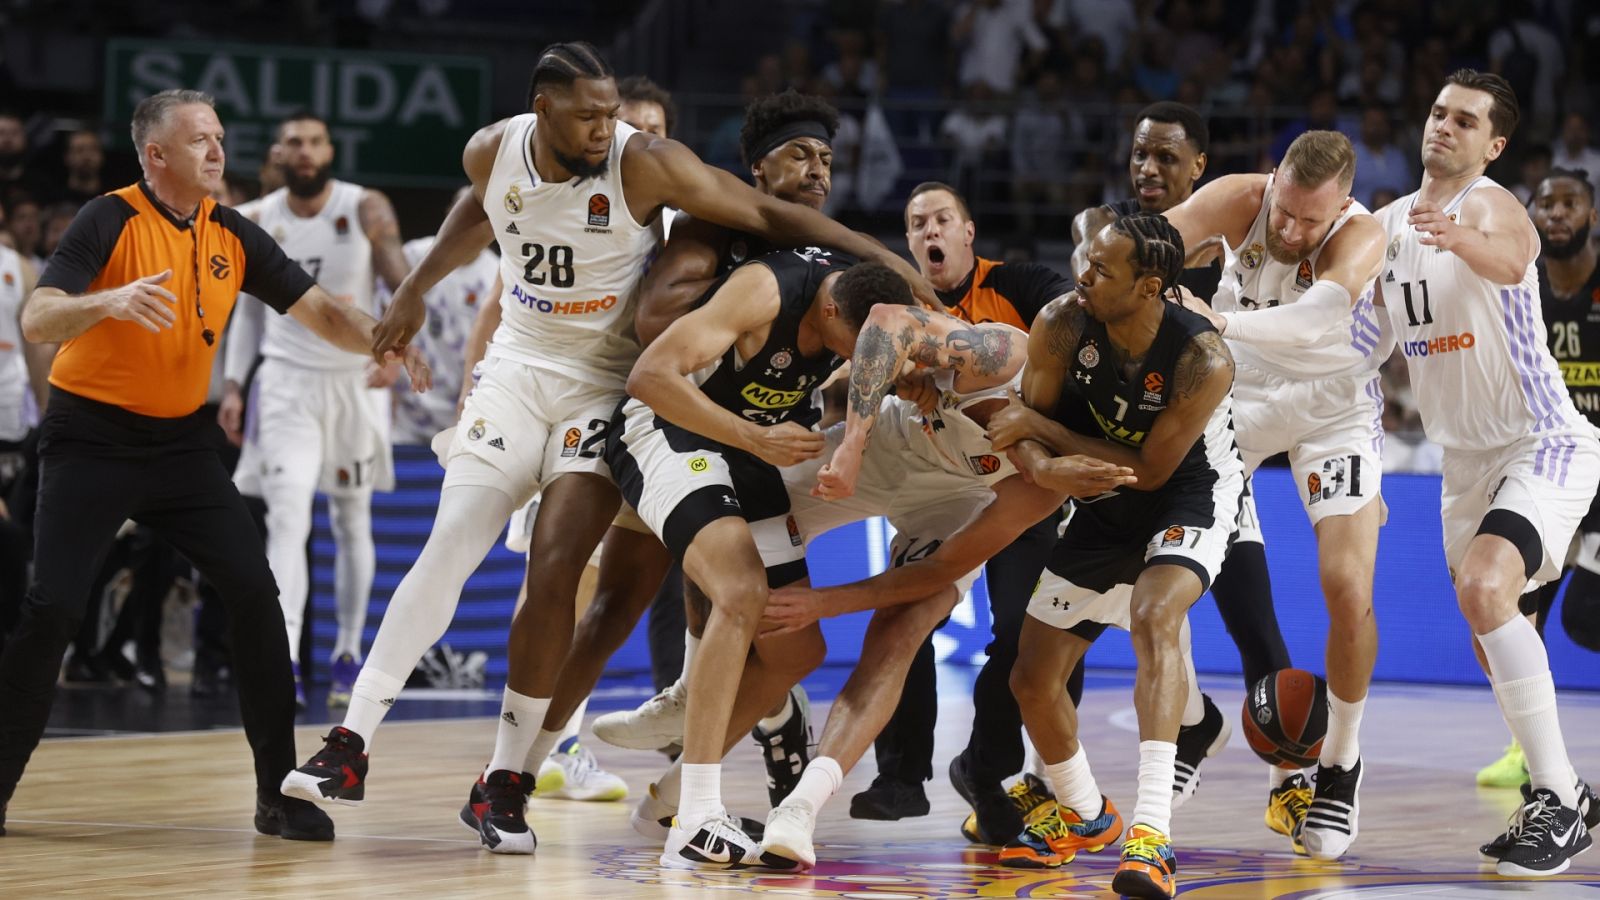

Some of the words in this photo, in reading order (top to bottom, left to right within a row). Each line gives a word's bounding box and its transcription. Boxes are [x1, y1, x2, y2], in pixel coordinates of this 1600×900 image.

[130, 49, 464, 128] SALIDA
[522, 243, 575, 288] 28
[512, 284, 617, 315] AUTOHERO
[1401, 280, 1433, 327] 11
[1552, 321, 1581, 358] 26
[1113, 394, 1129, 422] 7
[1322, 455, 1363, 500] 31
[1190, 529, 1202, 549] 7
